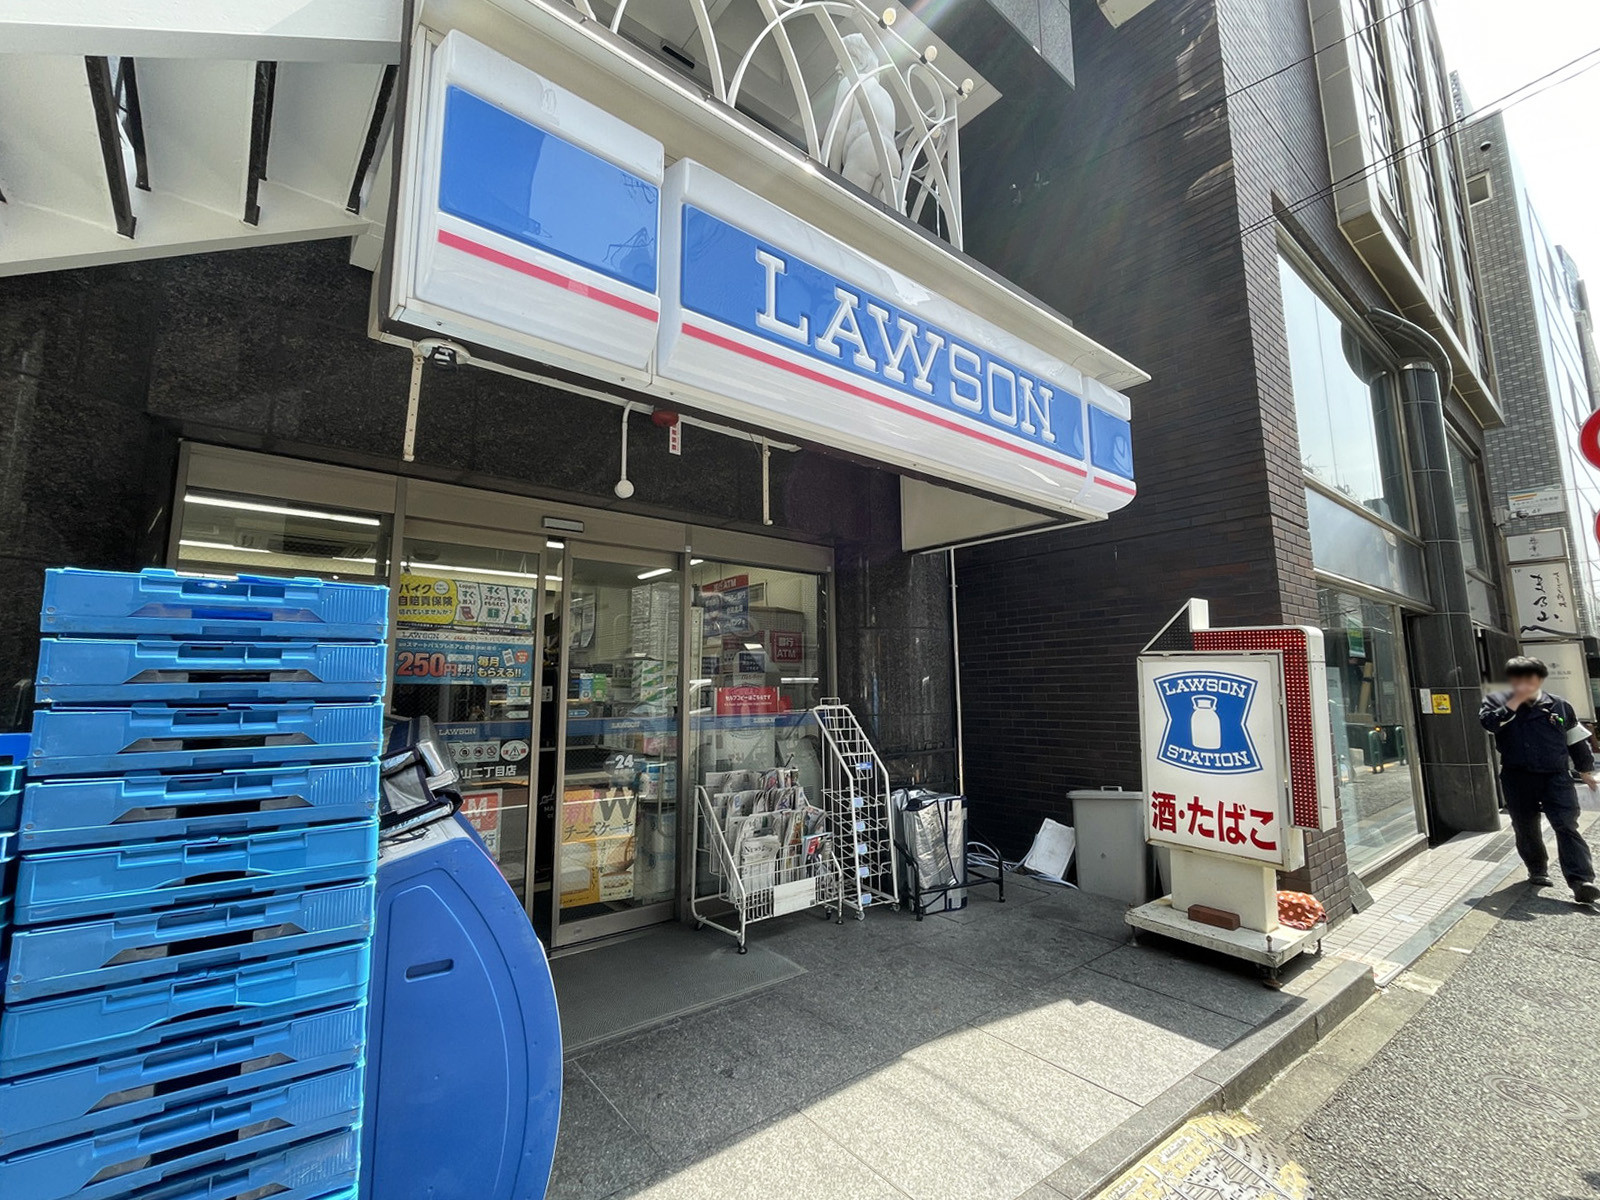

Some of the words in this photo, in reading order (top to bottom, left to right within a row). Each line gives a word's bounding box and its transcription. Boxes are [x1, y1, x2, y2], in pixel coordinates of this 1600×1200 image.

[755, 249, 1058, 444] LAWSON
[399, 583, 432, 594] バイク
[398, 595, 453, 607] 自賠責保険
[777, 649, 797, 658] ATM
[478, 655, 499, 667] 毎月
[477, 667, 522, 678] もらえる!!
[1162, 678, 1248, 698] LAWSON
[438, 727, 477, 736] LAWSON
[615, 754, 634, 769] 24
[1166, 744, 1250, 768] STATION
[1151, 790, 1277, 851] 酒・たばこ
[564, 819, 633, 841] チーズケーキ
